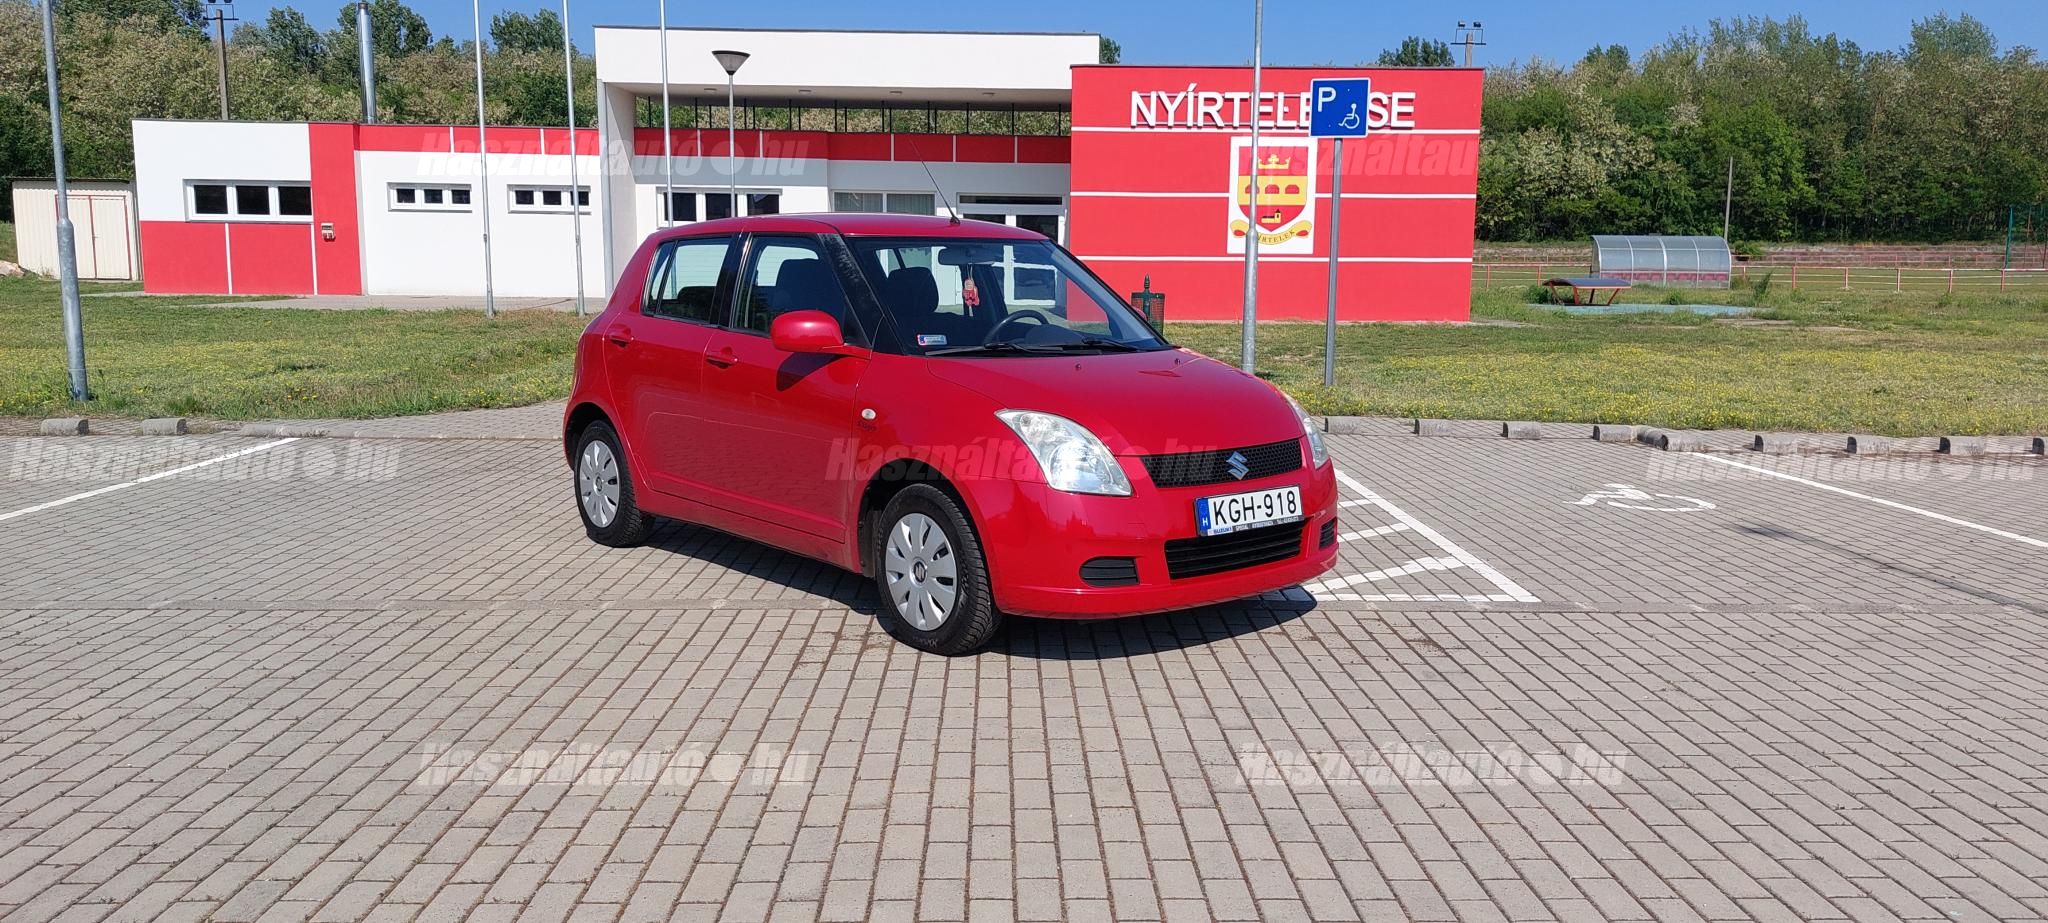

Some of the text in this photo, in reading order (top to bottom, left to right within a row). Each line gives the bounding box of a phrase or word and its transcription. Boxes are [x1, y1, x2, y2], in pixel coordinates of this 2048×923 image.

[1131, 83, 1416, 127] NYÍRTELE SE
[1318, 87, 1337, 112] P
[1202, 517, 1208, 526] H
[1213, 490, 1297, 525] KGH-918
